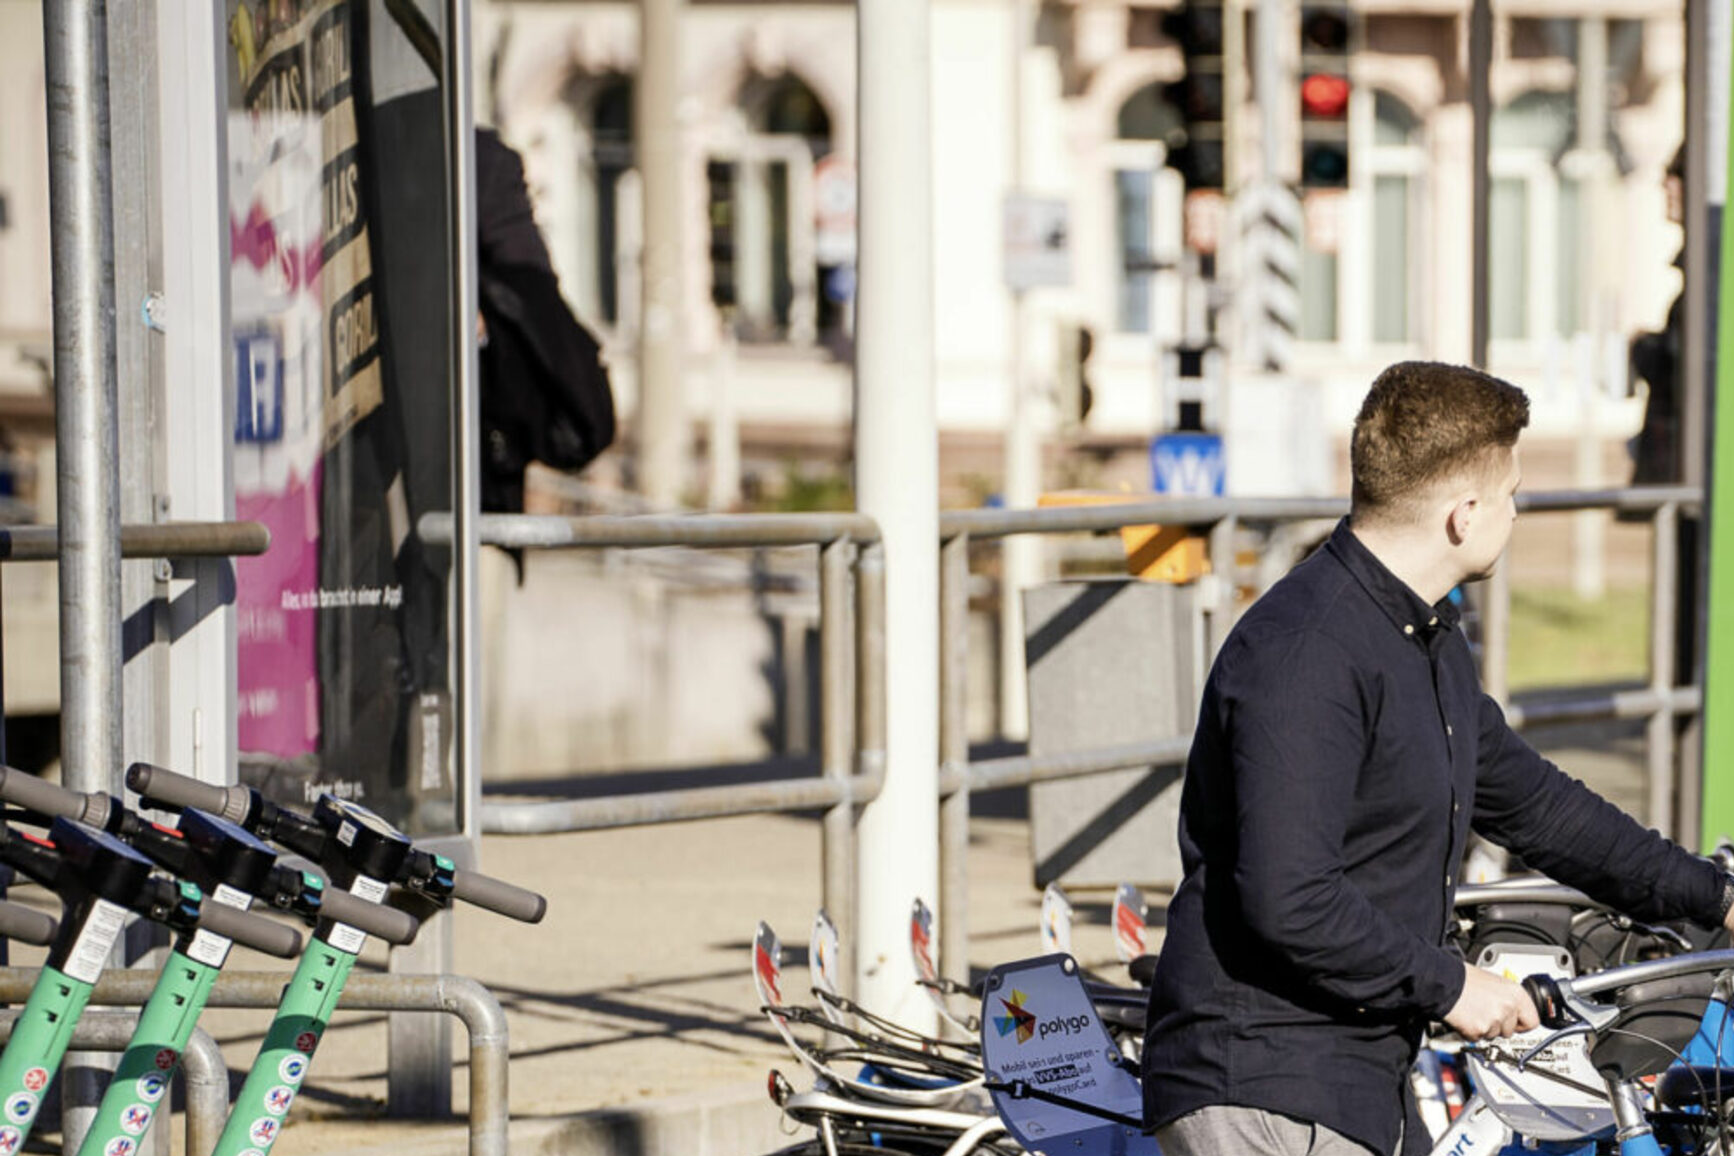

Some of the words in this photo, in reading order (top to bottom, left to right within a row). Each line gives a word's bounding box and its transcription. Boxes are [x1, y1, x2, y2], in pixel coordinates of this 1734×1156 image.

[1038, 1015, 1090, 1040] polygo
[1001, 1061, 1027, 1074] Mobil
[1047, 1053, 1064, 1065] und
